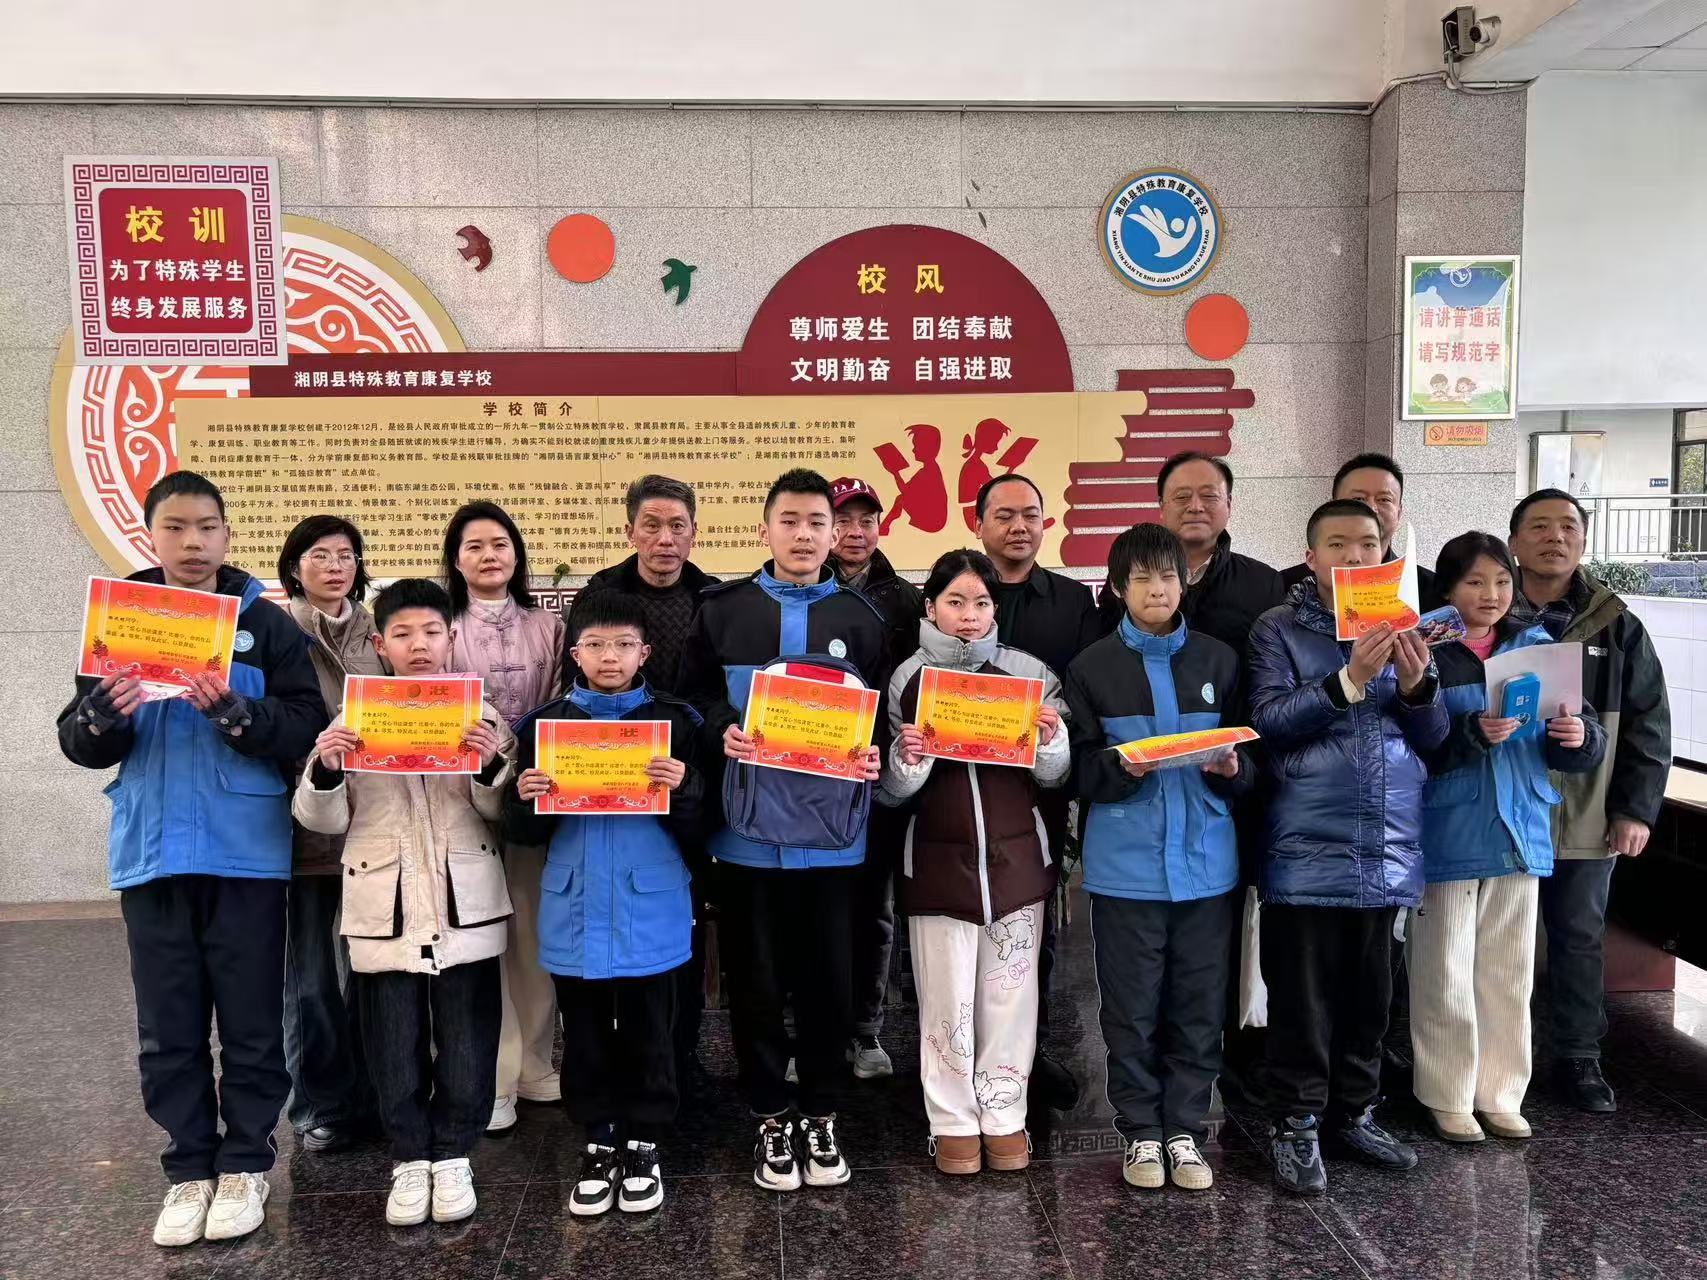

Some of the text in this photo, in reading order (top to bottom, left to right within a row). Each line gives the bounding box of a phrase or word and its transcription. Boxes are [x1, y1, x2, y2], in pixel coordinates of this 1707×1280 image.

[1113, 178, 1209, 218] 湘阴县特殊教育康复学校
[125, 205, 227, 244] 校训
[1111, 230, 1120, 250] XIANG
[1116, 248, 1125, 261] YIN
[1122, 260, 1136, 273] XIAN
[1135, 270, 1143, 278] TE
[1142, 274, 1156, 283] SHU
[1180, 265, 1195, 278] KANG
[1193, 257, 1201, 266] FU
[1199, 245, 1207, 259] XUE
[109, 258, 247, 283] 为了特殊学生
[857, 263, 945, 295] 校风
[110, 294, 248, 320] 终身发展服务
[1418, 306, 1502, 329] 请讲普通话
[789, 315, 1013, 341] 尊师爱生 团结奉献
[1418, 341, 1501, 363] 请写规范字
[294, 369, 492, 388] 湘阴县特殊教育康复学校
[790, 356, 1013, 383] 文明勤奋 自强进取
[483, 401, 573, 417] 学校简介
